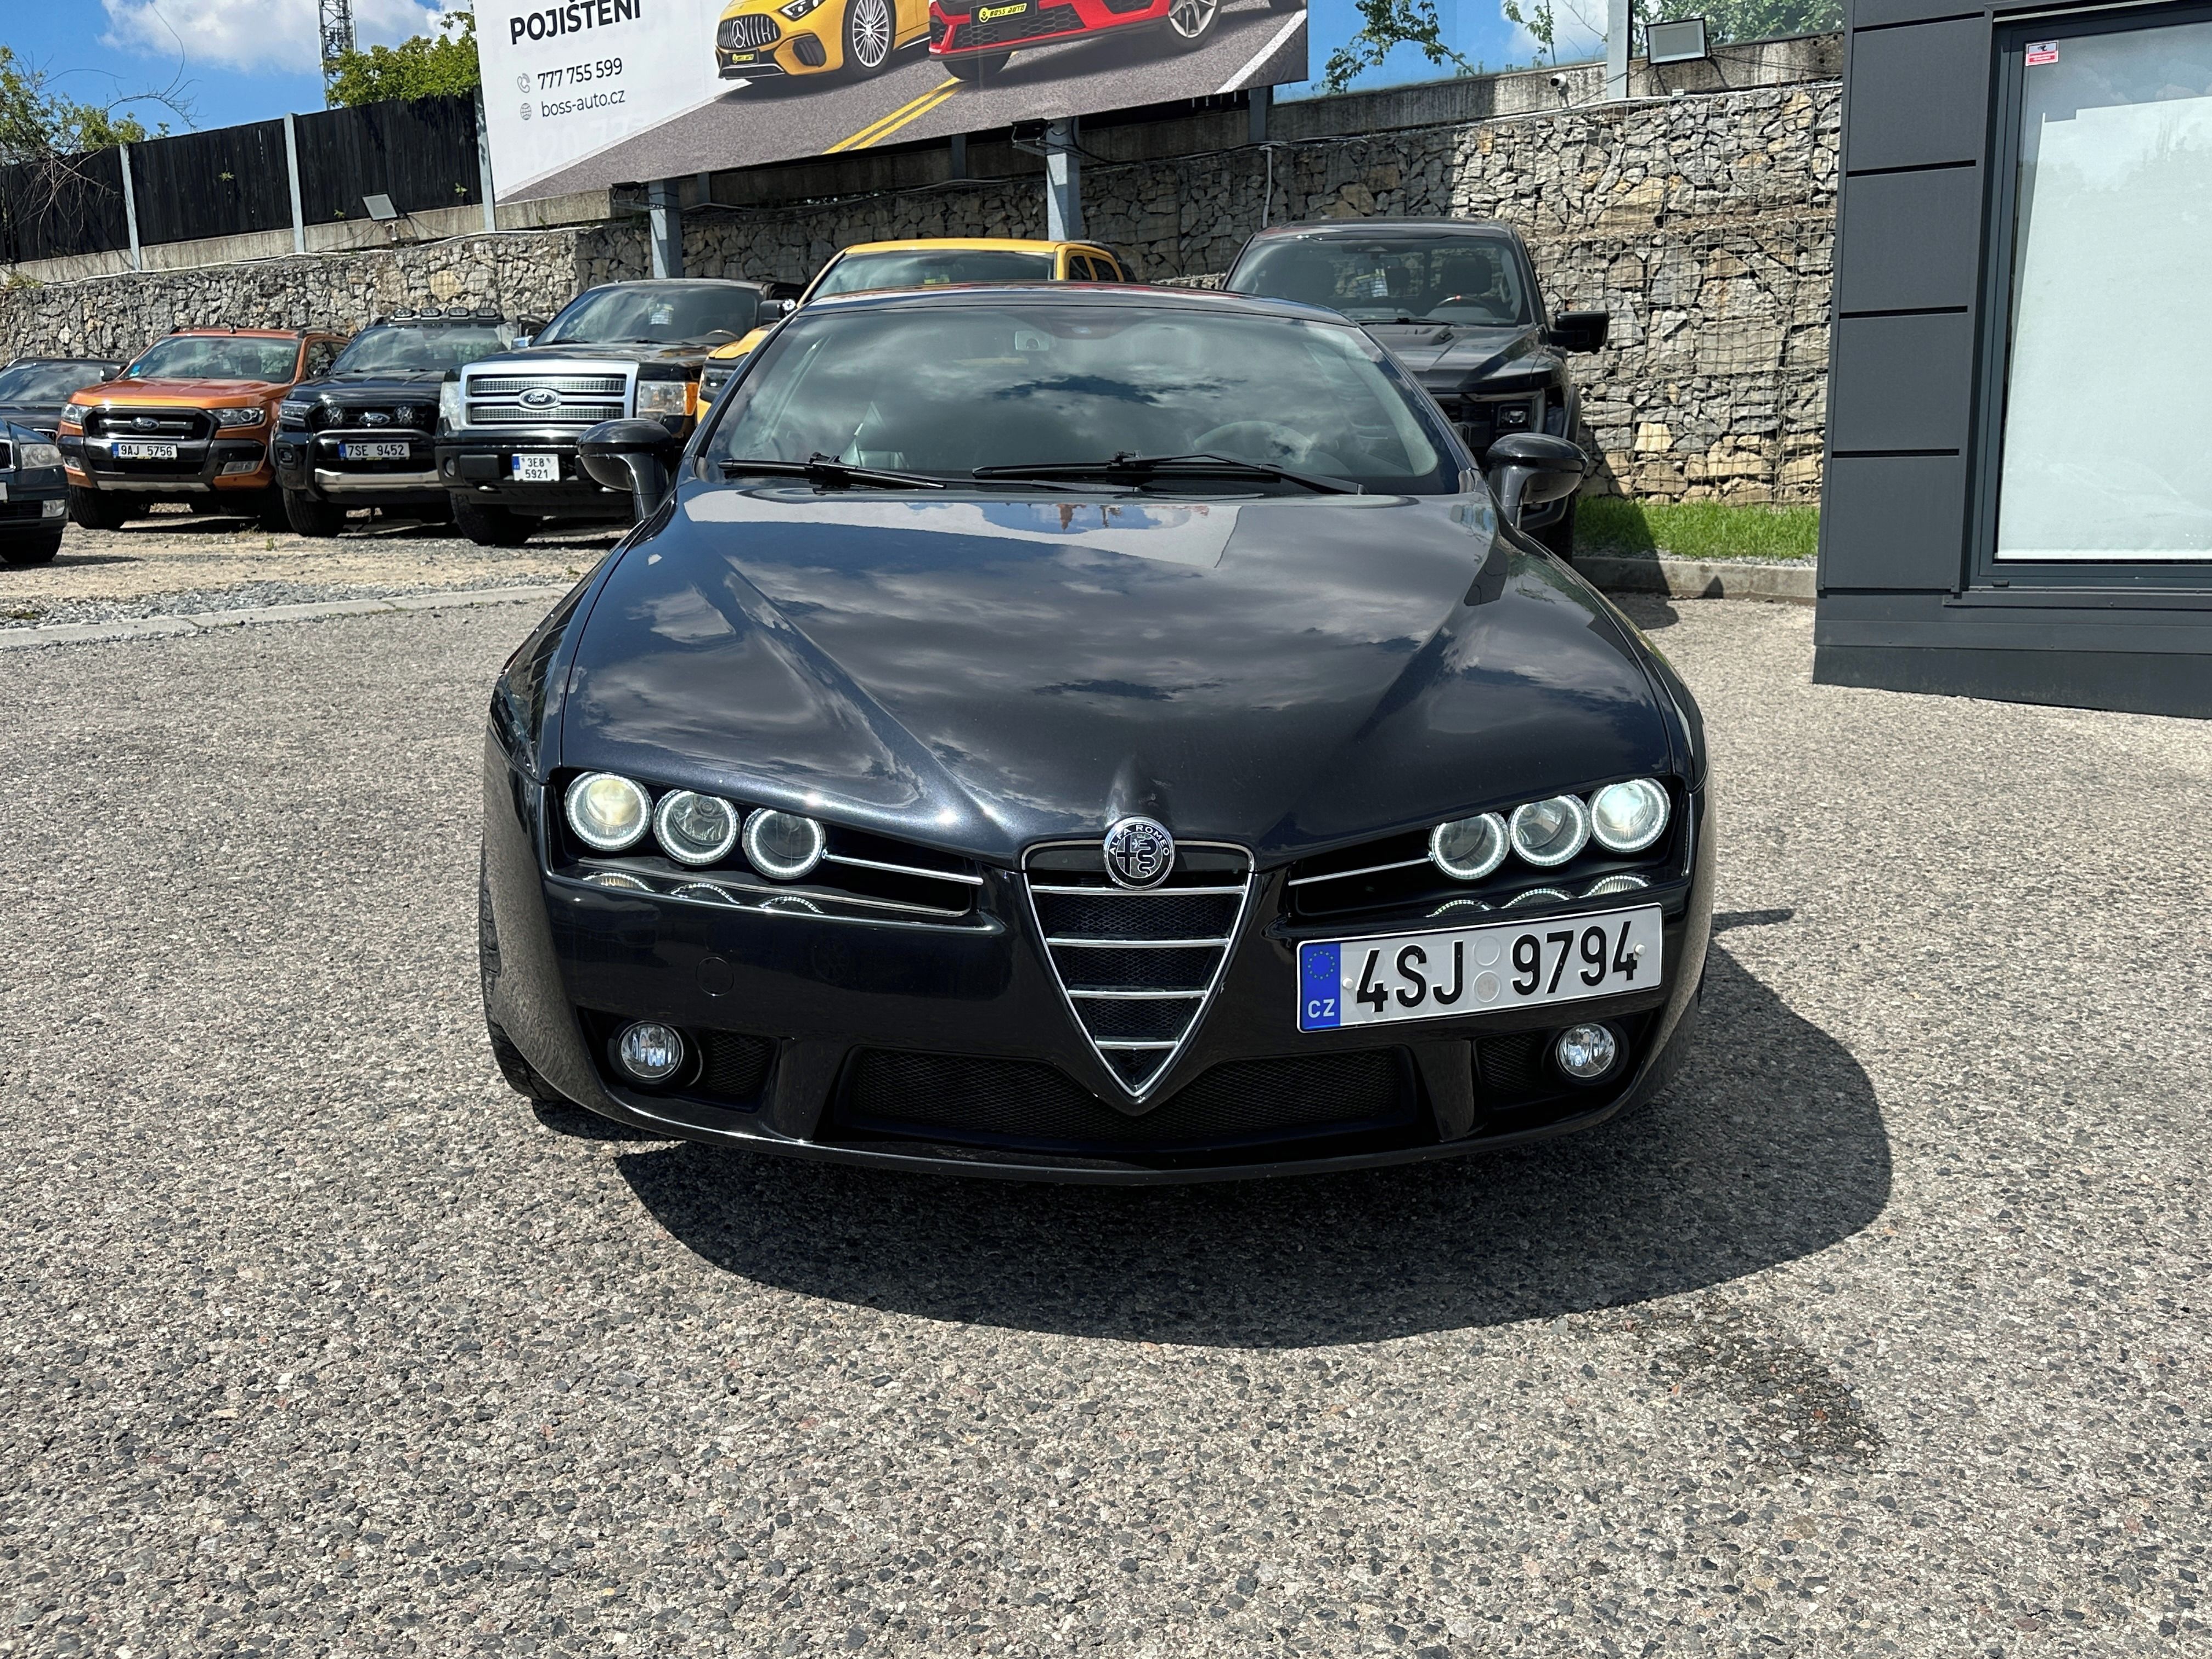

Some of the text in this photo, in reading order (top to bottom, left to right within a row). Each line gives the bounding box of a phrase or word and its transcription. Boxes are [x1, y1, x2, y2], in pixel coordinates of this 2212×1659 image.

[538, 57, 623, 90] 777 755 599
[541, 89, 625, 117] boss-auto.cz
[528, 391, 548, 403] Ford
[121, 444, 139, 456] 9AJ
[147, 445, 173, 456] 5756
[348, 444, 405, 456] 7SE 9452
[527, 458, 545, 467] 3E8
[525, 469, 548, 479] 5921
[1109, 825, 1170, 856] ALFA ROMEO
[1356, 921, 1638, 1013] 4SJ 9794
[1307, 998, 1335, 1019] CZ
